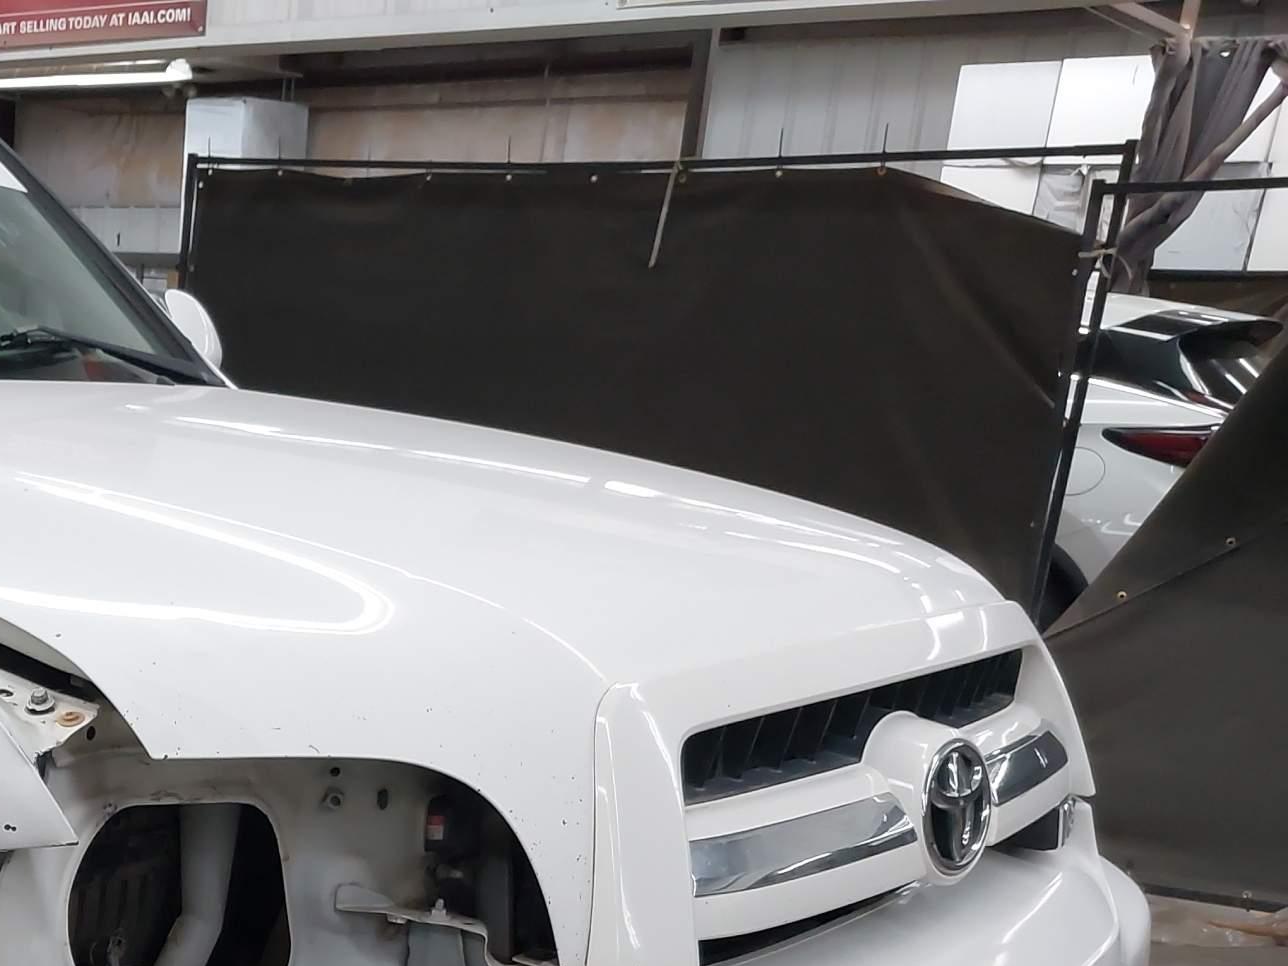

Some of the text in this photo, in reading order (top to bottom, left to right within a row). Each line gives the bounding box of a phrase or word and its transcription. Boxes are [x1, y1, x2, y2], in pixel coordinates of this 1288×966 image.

[19, 18, 66, 34] SELLING
[68, 14, 107, 30] TODAY
[109, 13, 125, 27] AT
[127, 8, 191, 26] IAAI.COM!
